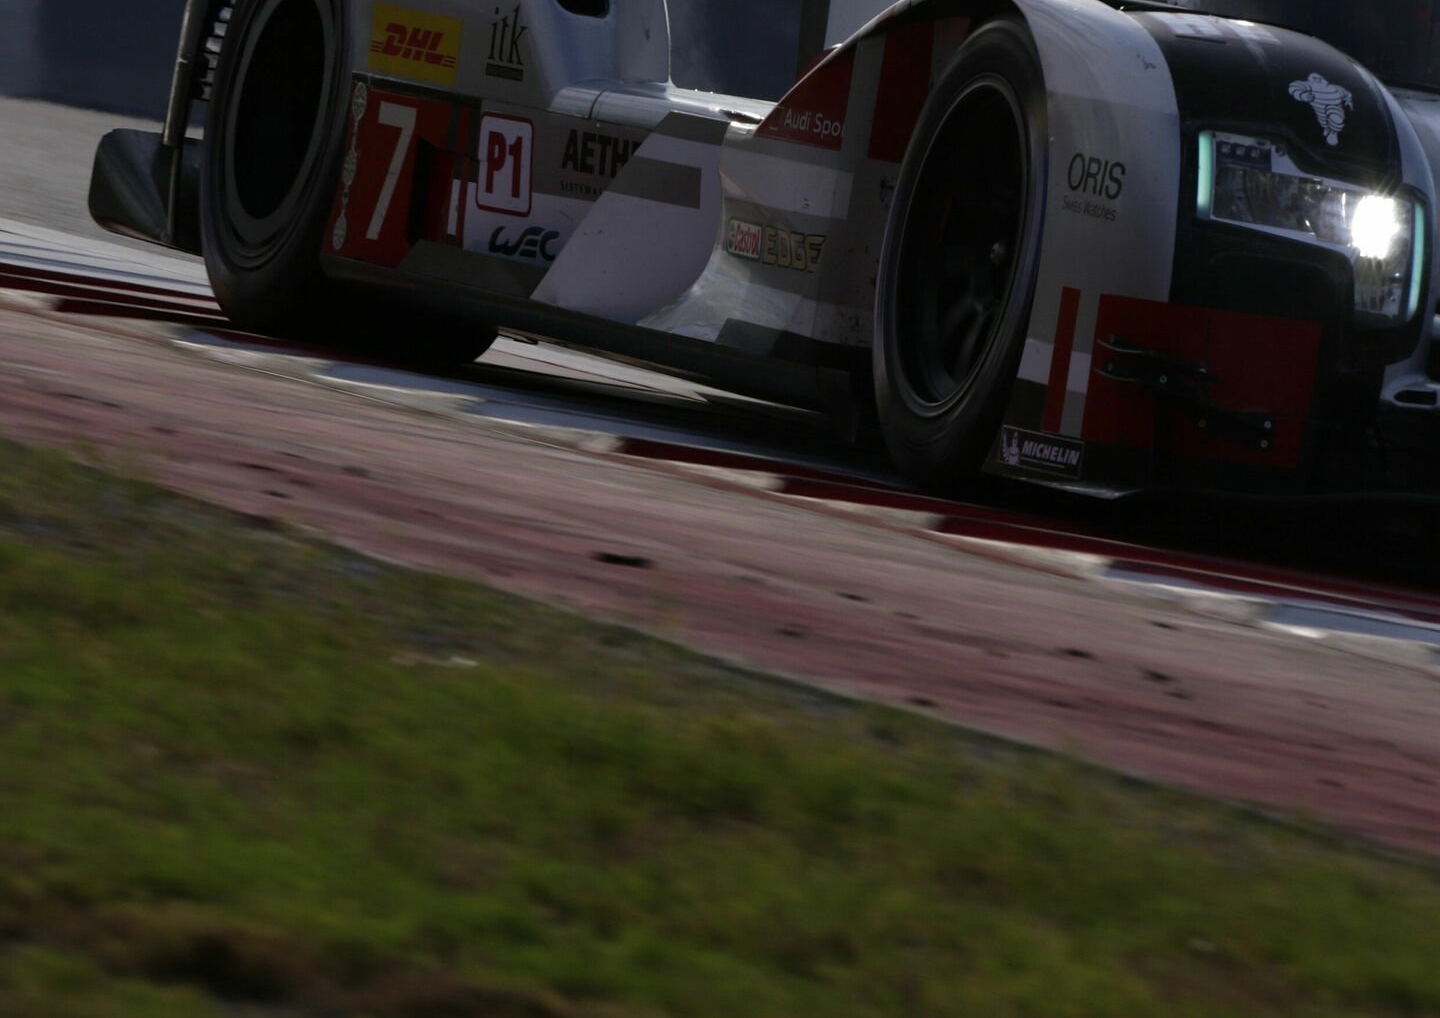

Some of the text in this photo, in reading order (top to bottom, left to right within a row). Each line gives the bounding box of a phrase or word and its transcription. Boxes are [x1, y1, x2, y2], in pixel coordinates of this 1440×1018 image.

[381, 22, 445, 66] DHL
[487, 3, 529, 65] itk
[783, 107, 813, 132] Audi
[364, 100, 419, 242] 7
[486, 131, 524, 199] P1
[1067, 152, 1127, 201] ORIS
[488, 225, 560, 262] WEC
[762, 224, 828, 273] EDGE
[1021, 439, 1081, 466] MICHELIN
